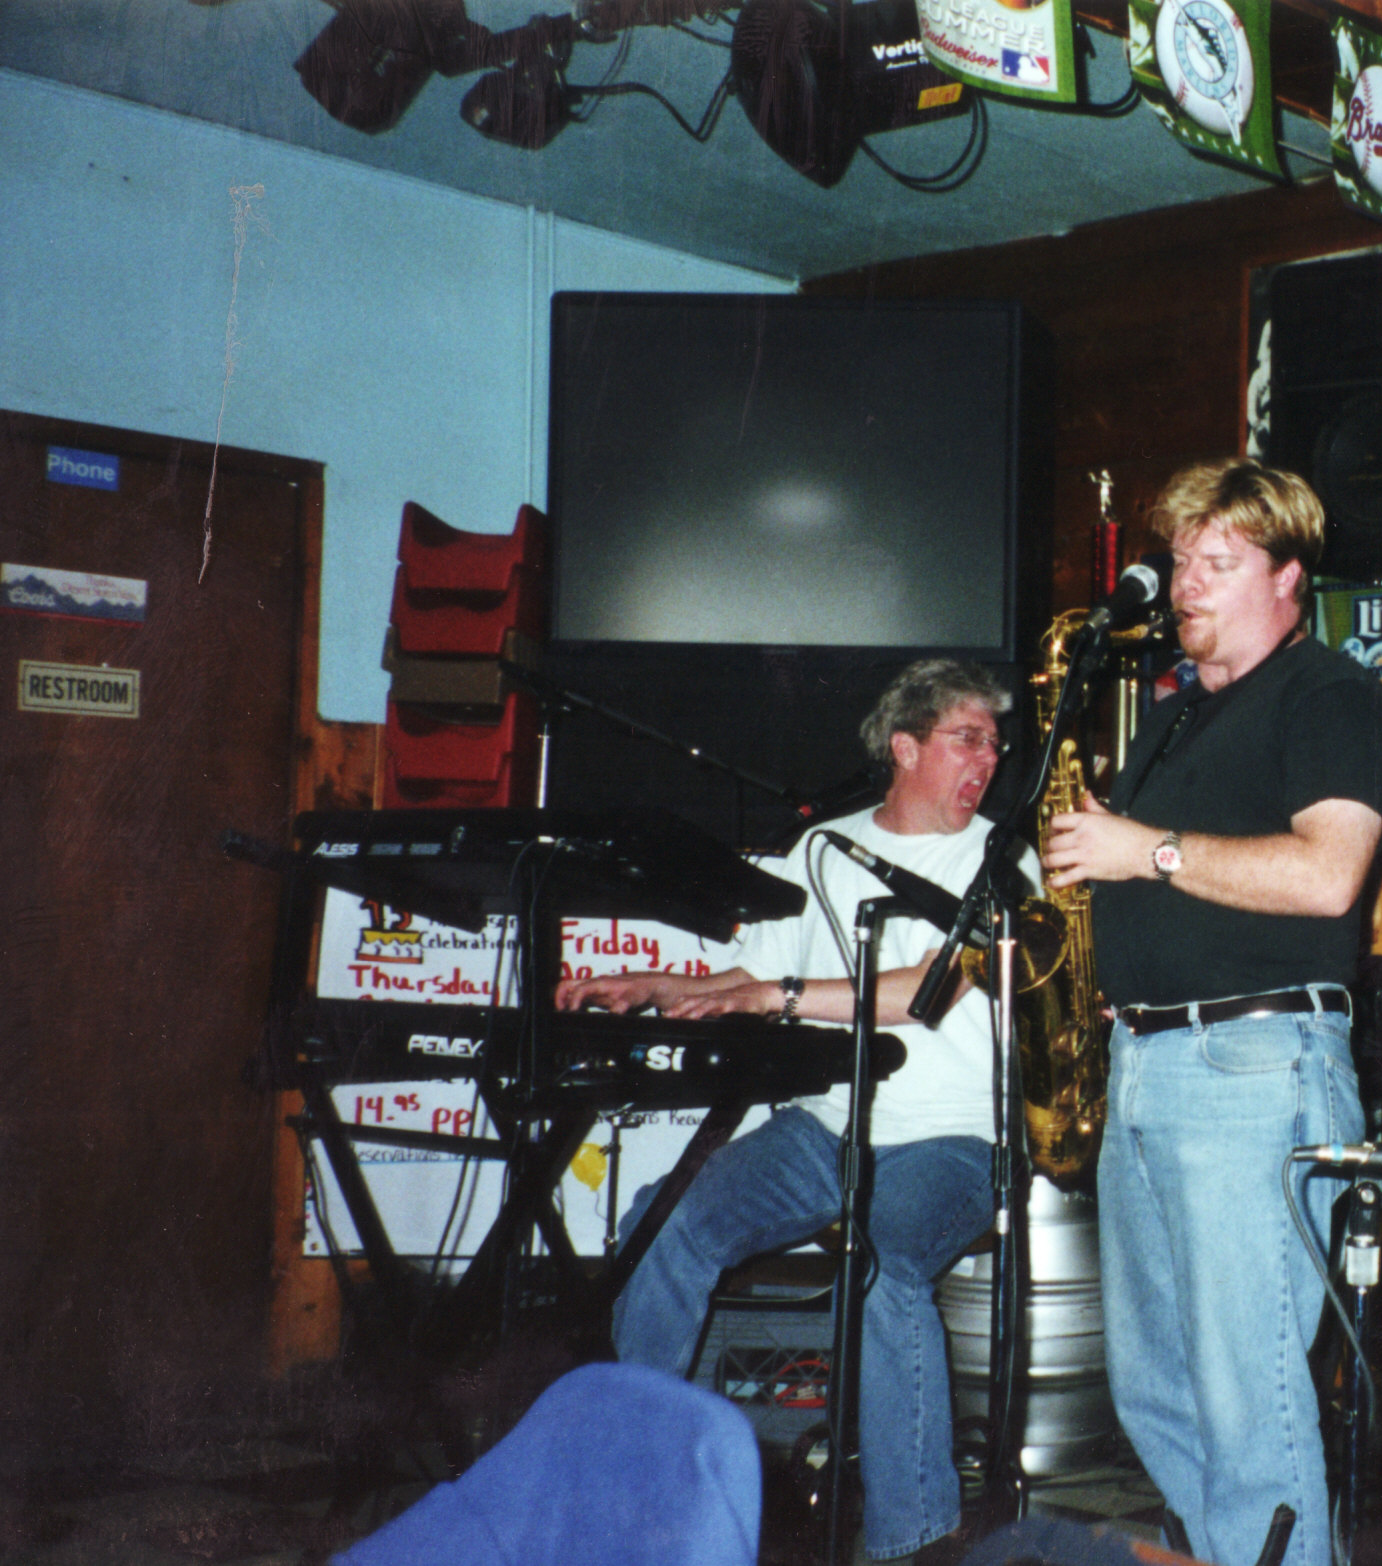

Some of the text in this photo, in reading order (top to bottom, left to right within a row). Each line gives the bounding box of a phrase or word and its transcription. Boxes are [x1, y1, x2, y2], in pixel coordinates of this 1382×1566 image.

[919, 16, 999, 68] Budweiser
[47, 453, 117, 482] Phone
[29, 674, 129, 705] RESTROOM
[561, 917, 660, 968] Friday
[347, 965, 500, 1007] Thursday
[357, 1148, 441, 1162] eservations
